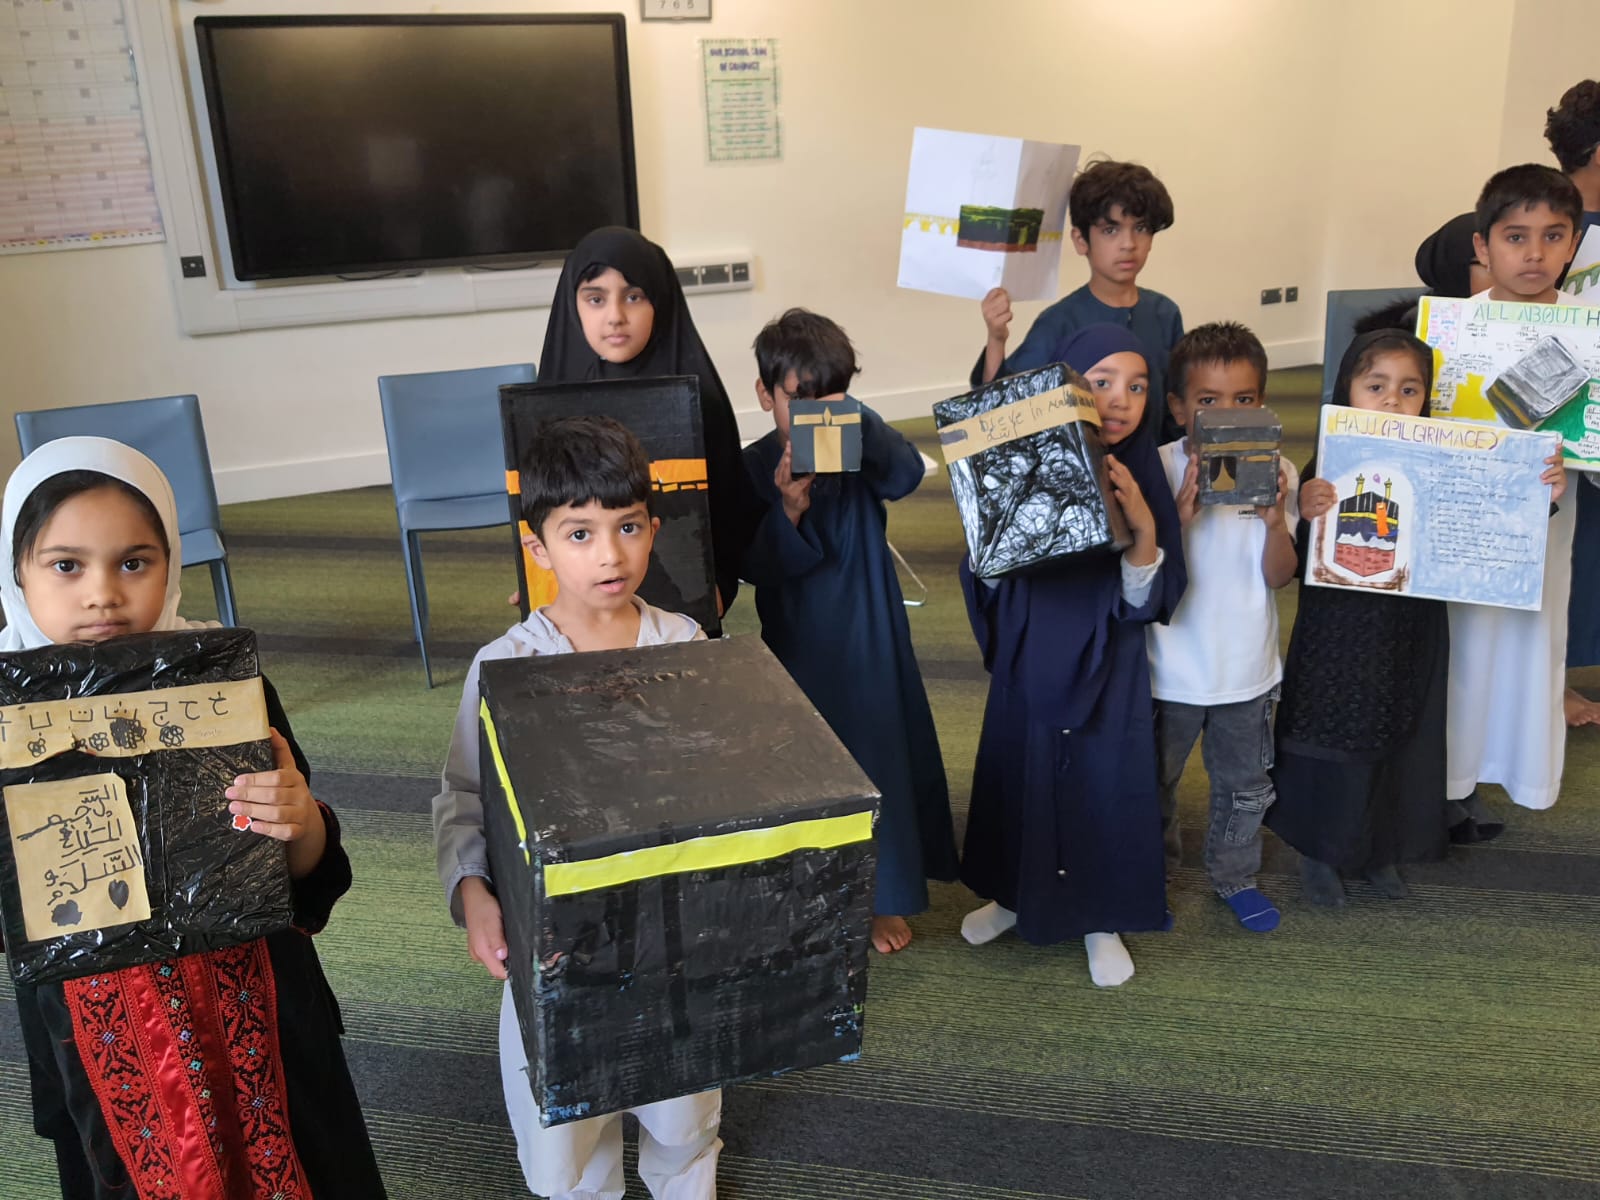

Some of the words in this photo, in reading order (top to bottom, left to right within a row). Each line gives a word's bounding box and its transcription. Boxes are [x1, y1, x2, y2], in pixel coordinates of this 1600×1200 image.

[1473, 303, 1509, 321] ALL
[1518, 304, 1581, 325] ABOUT
[1335, 411, 1377, 435] HAJJ
